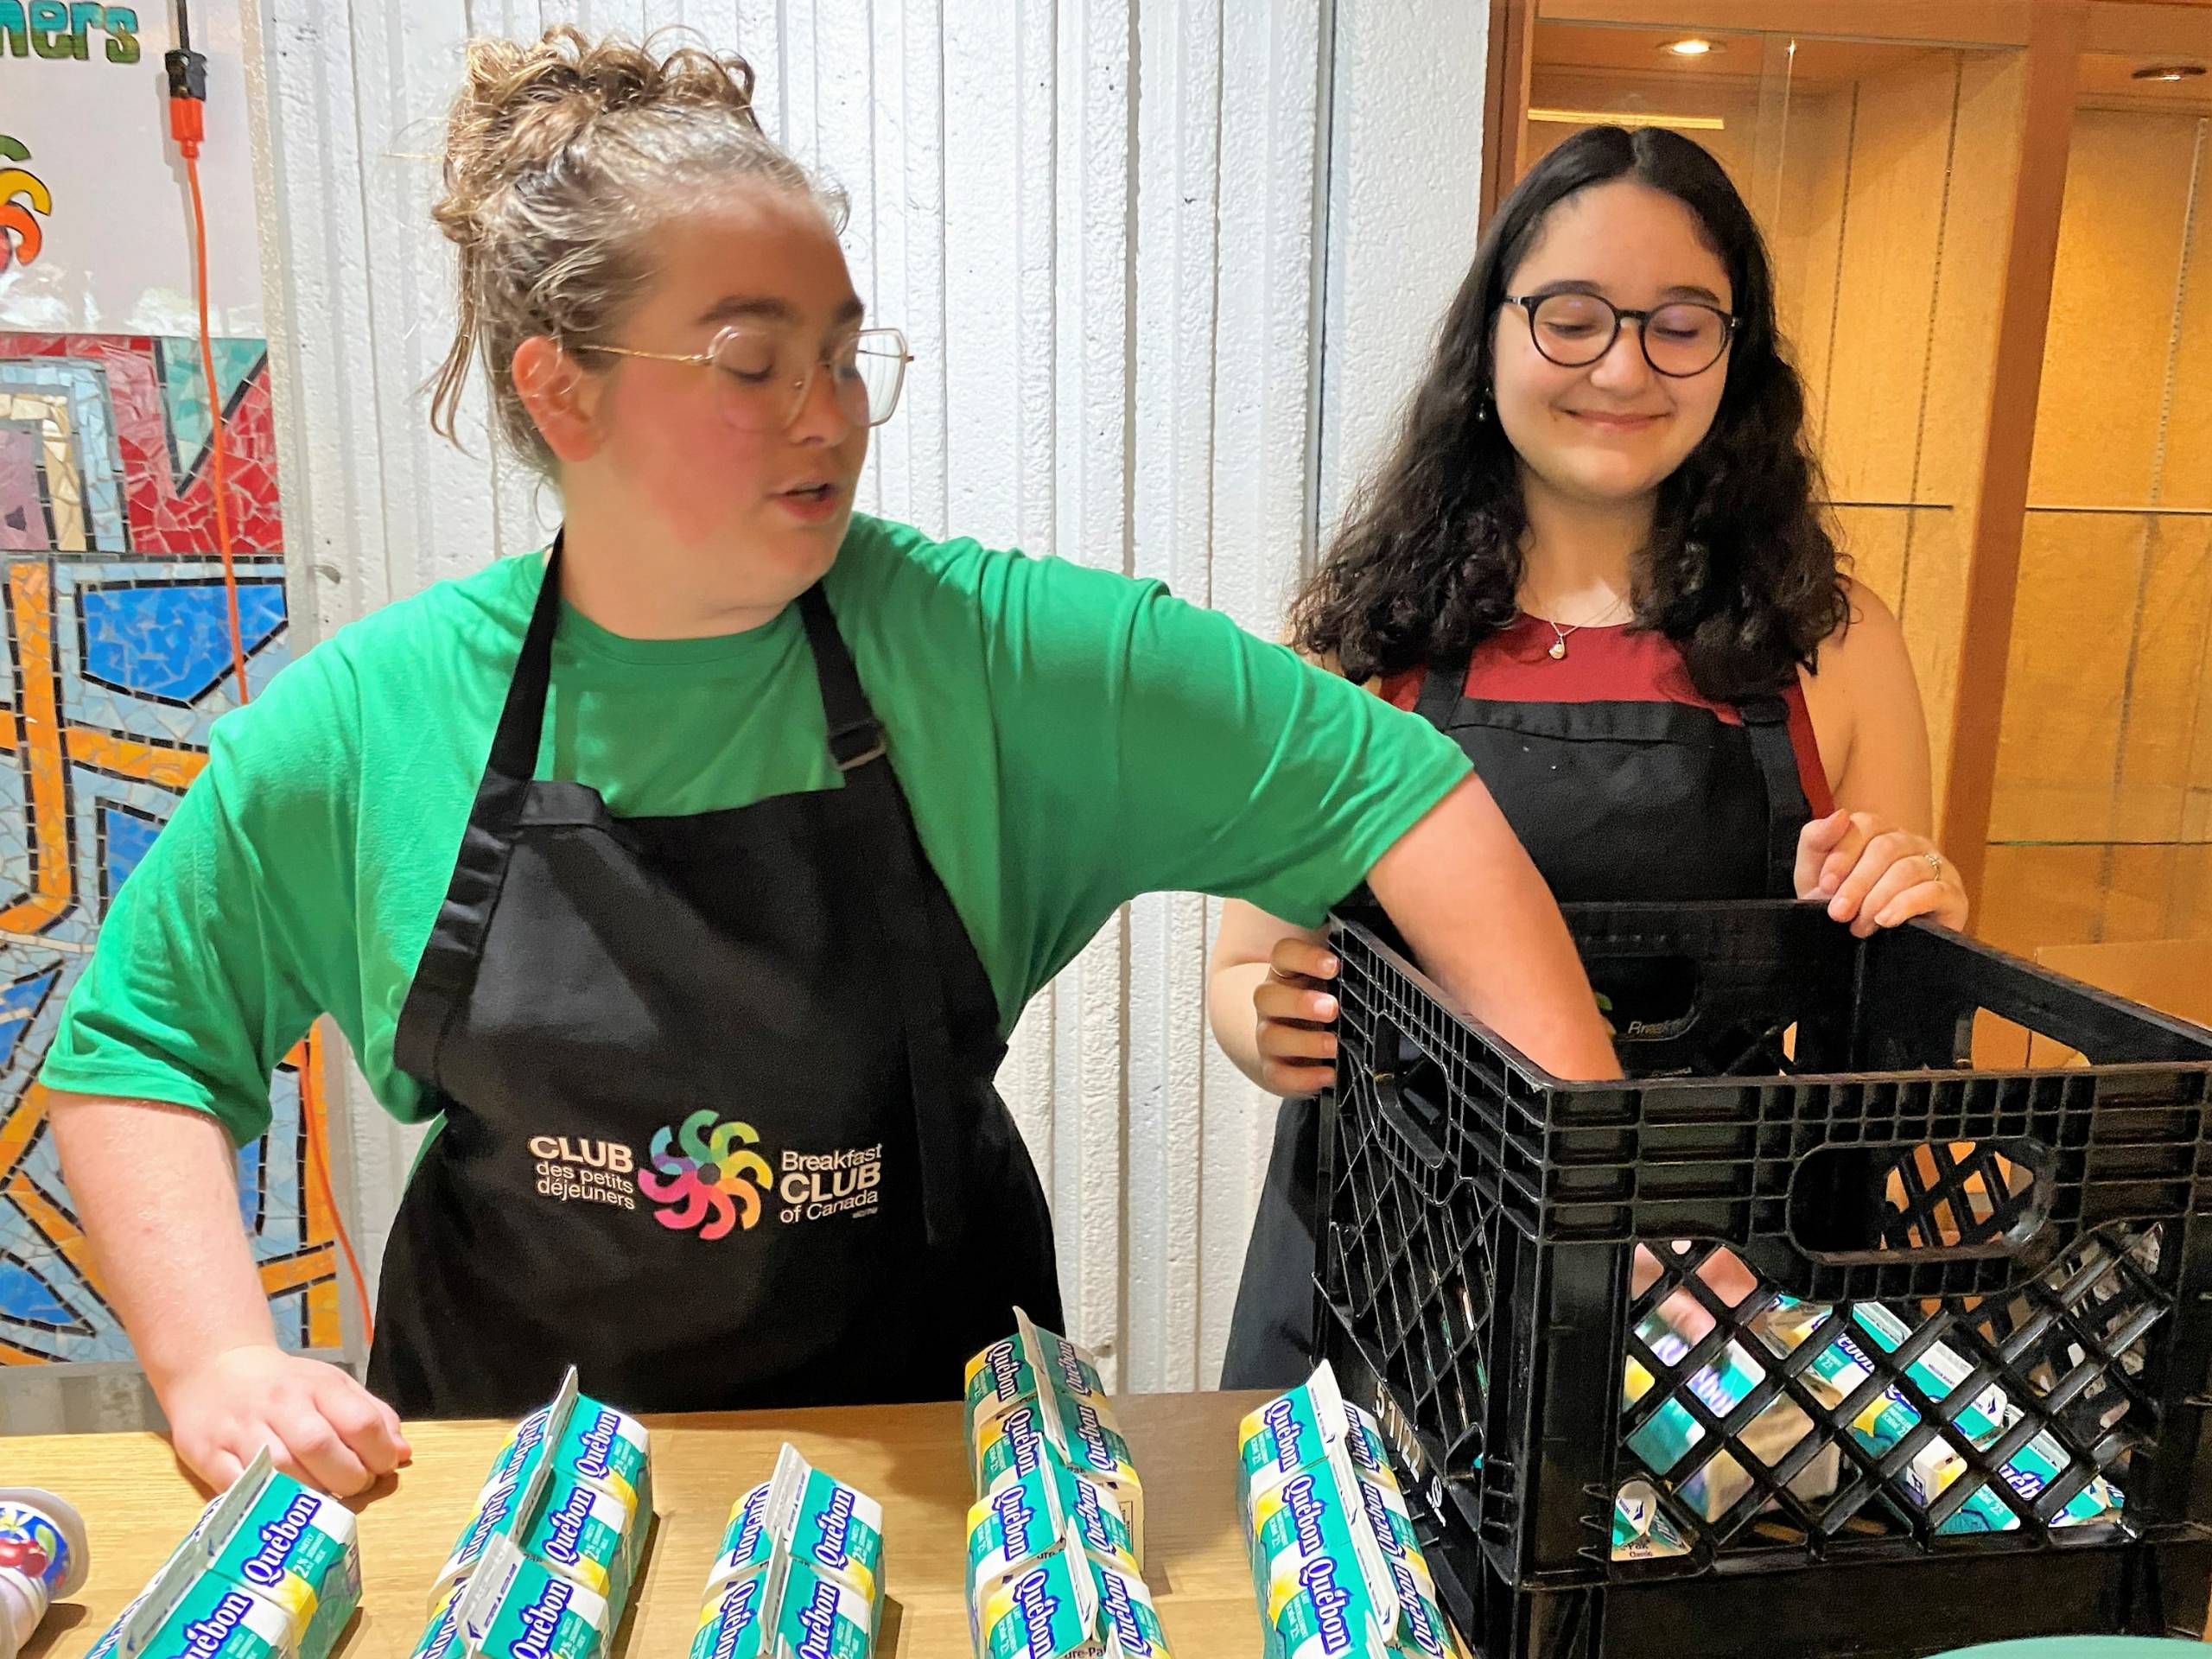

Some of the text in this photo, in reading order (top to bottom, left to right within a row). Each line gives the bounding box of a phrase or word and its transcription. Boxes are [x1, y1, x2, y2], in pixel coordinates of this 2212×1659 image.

[530, 1136, 633, 1173] CLUB
[781, 1143, 882, 1171] Breakfast
[537, 1161, 633, 1193] des petits
[537, 1177, 635, 1210] déjeuners
[780, 1162, 881, 1204] CLUB
[780, 1205, 802, 1224] of
[807, 1190, 878, 1220] Canada
